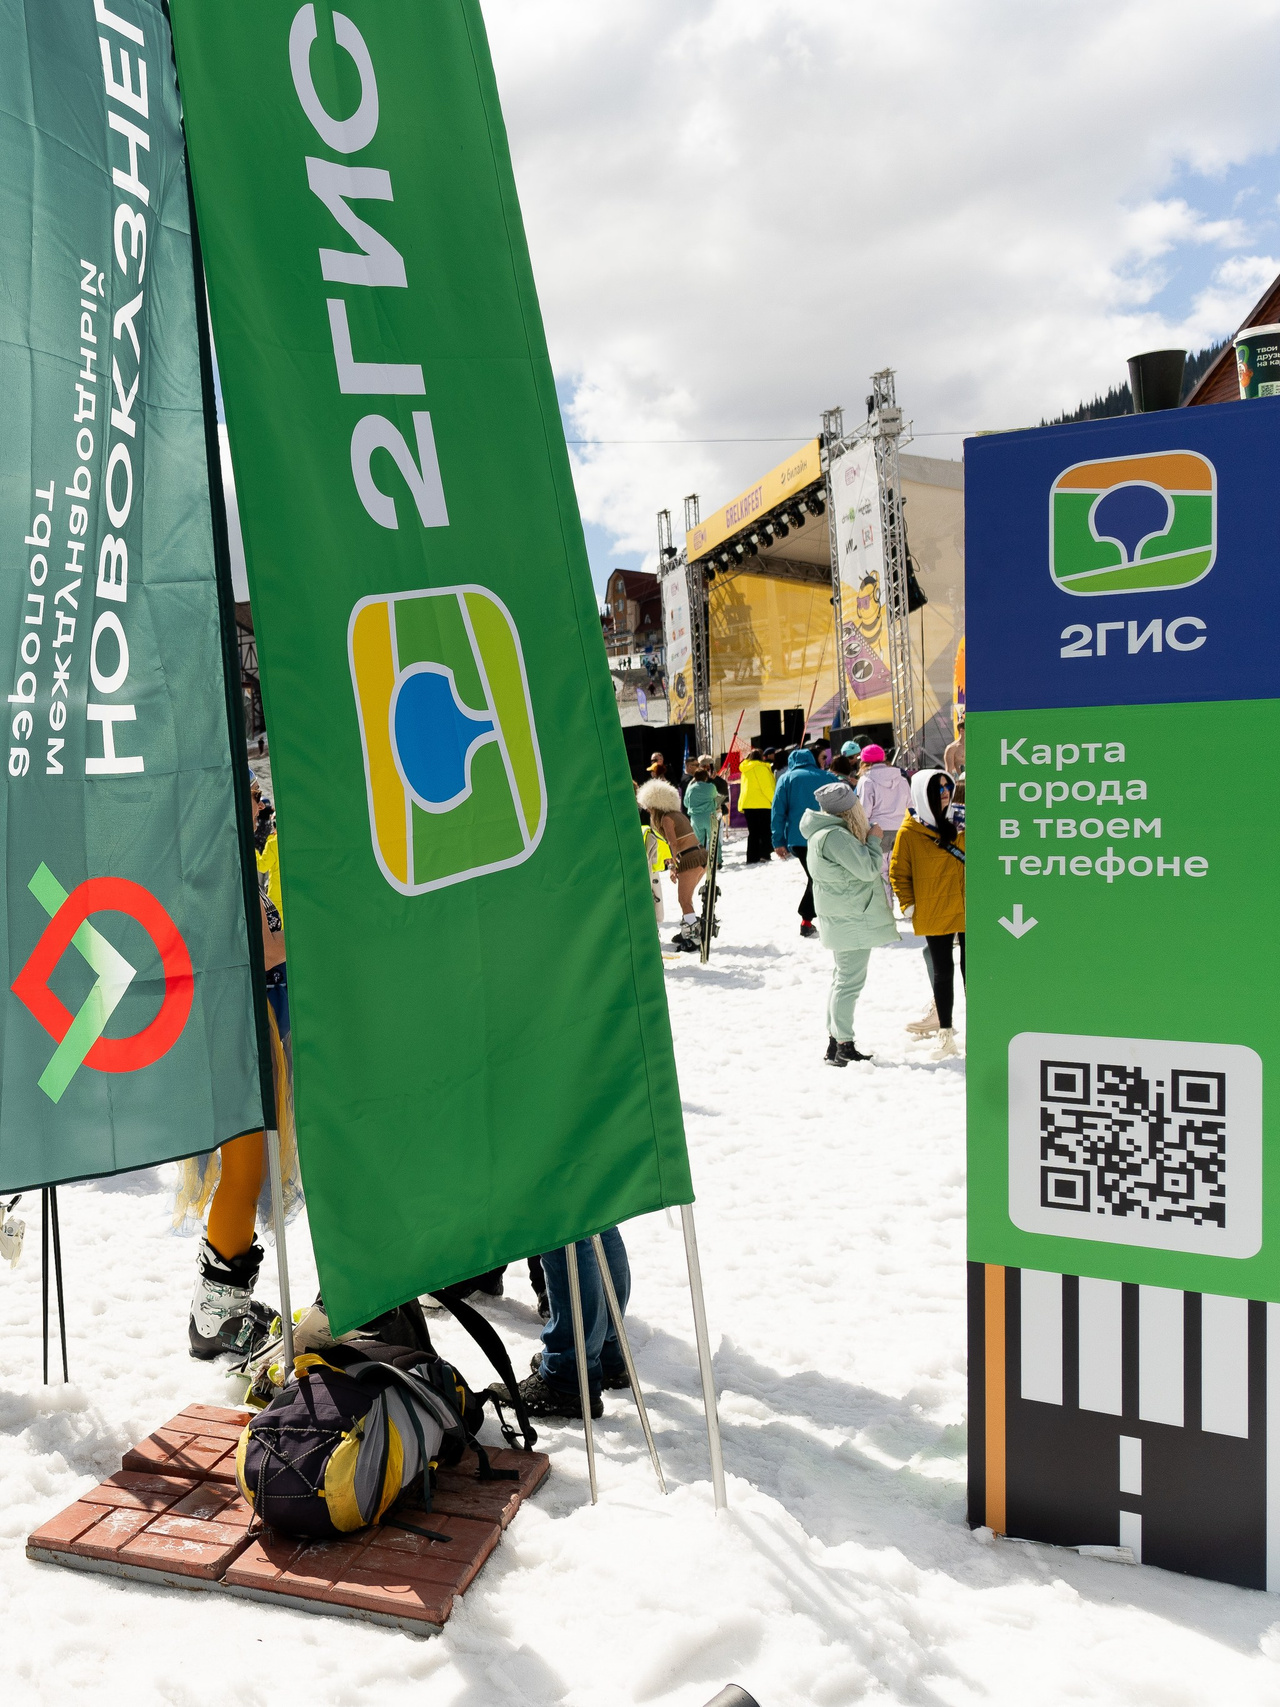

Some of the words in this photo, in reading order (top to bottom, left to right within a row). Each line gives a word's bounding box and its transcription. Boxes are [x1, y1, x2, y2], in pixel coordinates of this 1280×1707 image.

[289, 3, 449, 530] 2ГИС
[787, 460, 808, 481] билайн
[1060, 616, 1208, 659] 2ГИС
[1000, 737, 1126, 771] Карта
[999, 779, 1148, 809] города
[999, 818, 1021, 839] в
[1032, 817, 1162, 839] твоем
[998, 846, 1209, 884] телефоне
